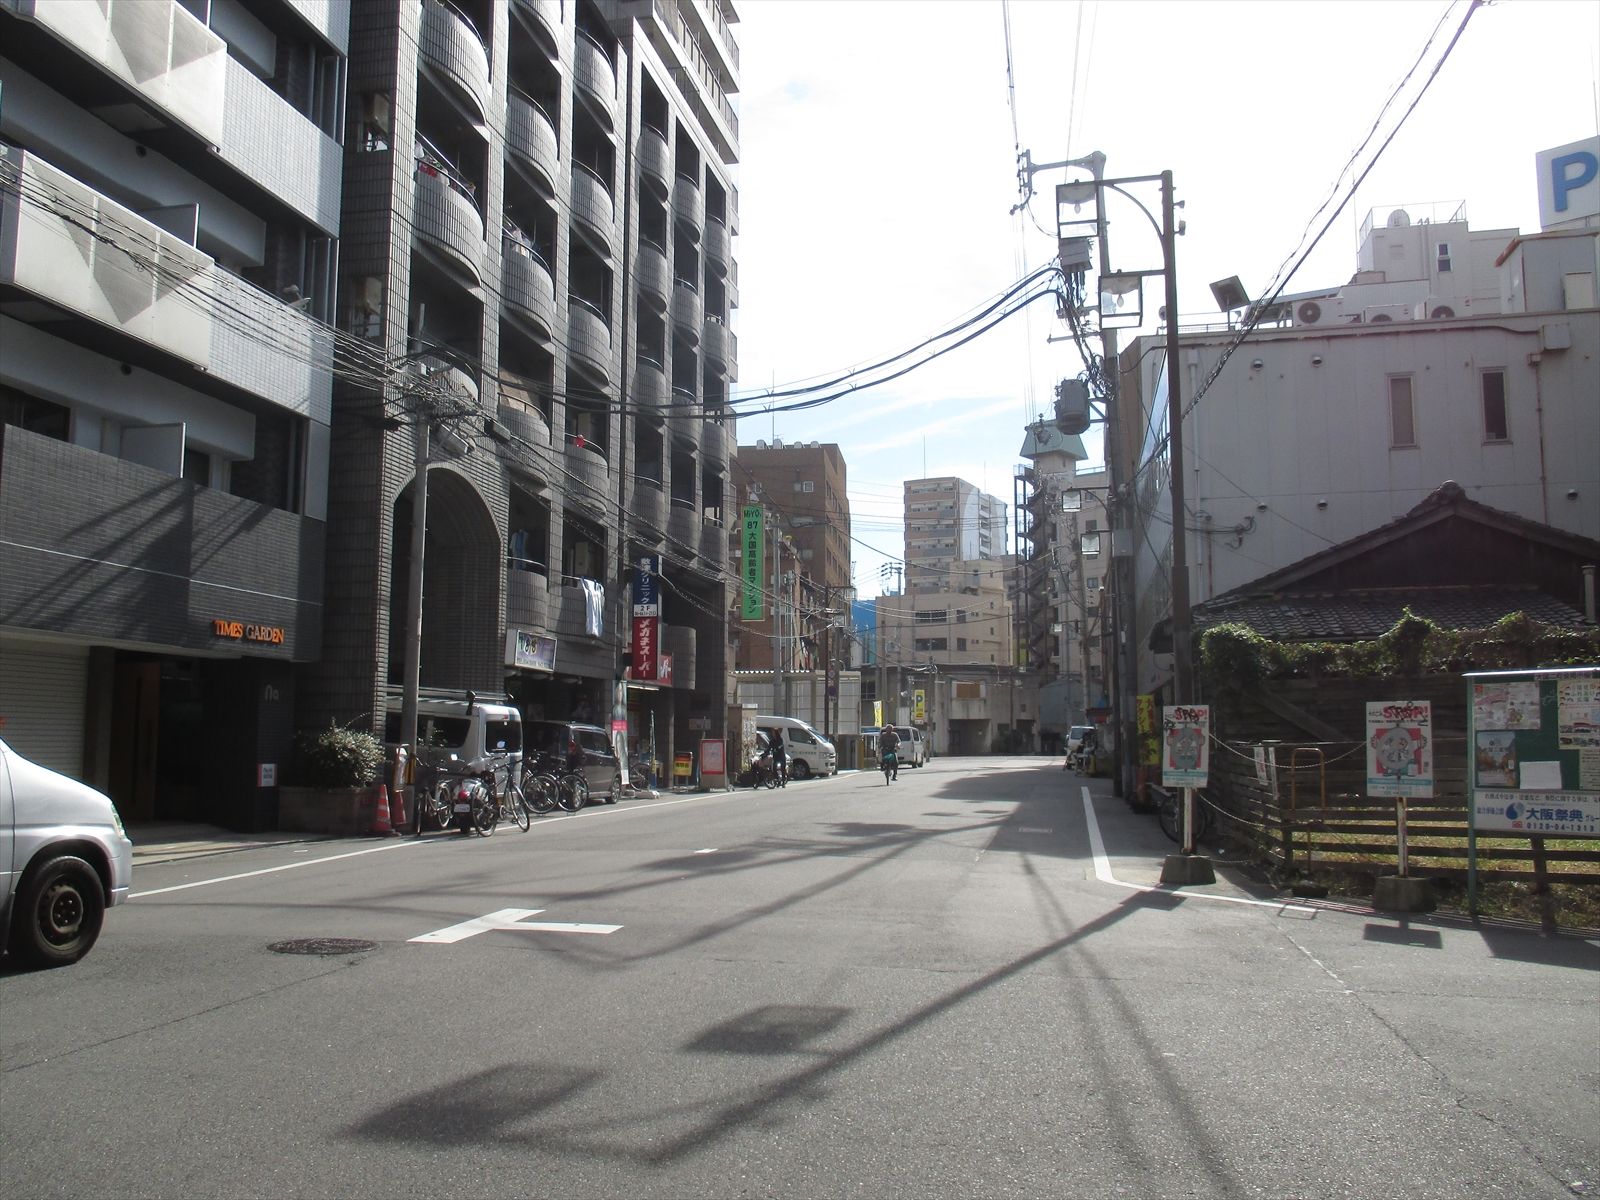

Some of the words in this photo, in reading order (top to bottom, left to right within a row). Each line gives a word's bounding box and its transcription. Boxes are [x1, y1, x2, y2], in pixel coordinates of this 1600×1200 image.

[1551, 151, 1599, 213] P
[213, 620, 244, 639] TIMES
[246, 624, 285, 644] GARDEN
[916, 694, 923, 707] P
[1526, 807, 1584, 823] 大阪祭典
